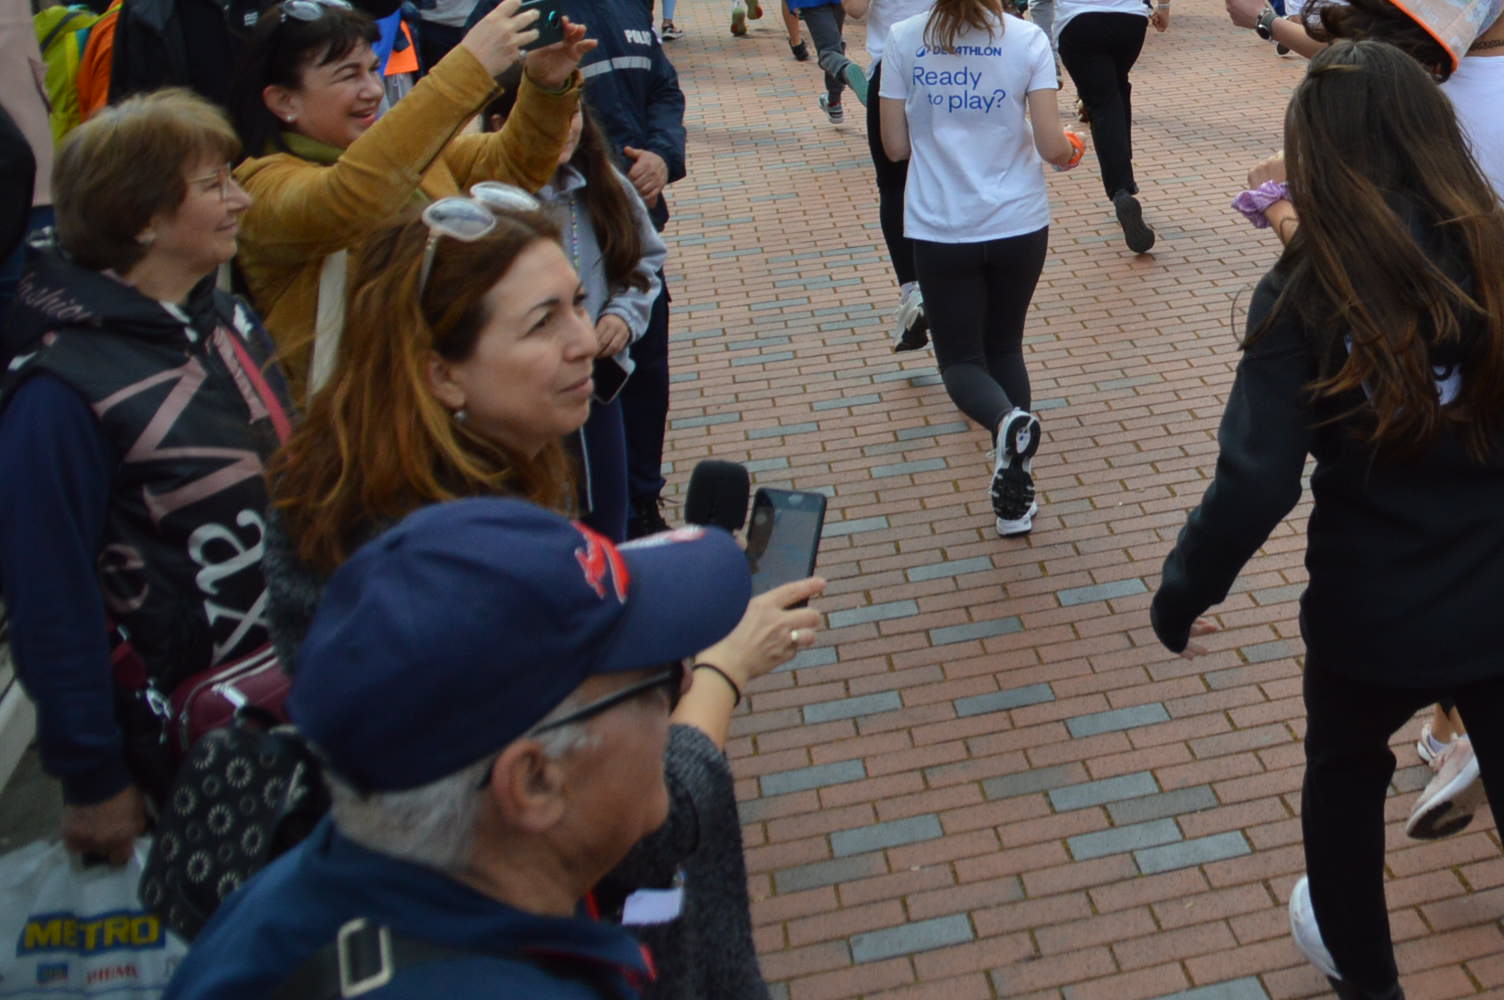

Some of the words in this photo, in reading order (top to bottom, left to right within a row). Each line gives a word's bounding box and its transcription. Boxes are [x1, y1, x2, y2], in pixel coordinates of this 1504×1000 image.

[932, 45, 1002, 57] DEATHLON
[912, 66, 982, 91] Ready
[928, 93, 944, 106] to
[948, 89, 1007, 114] play?
[24, 914, 161, 951] METRO
